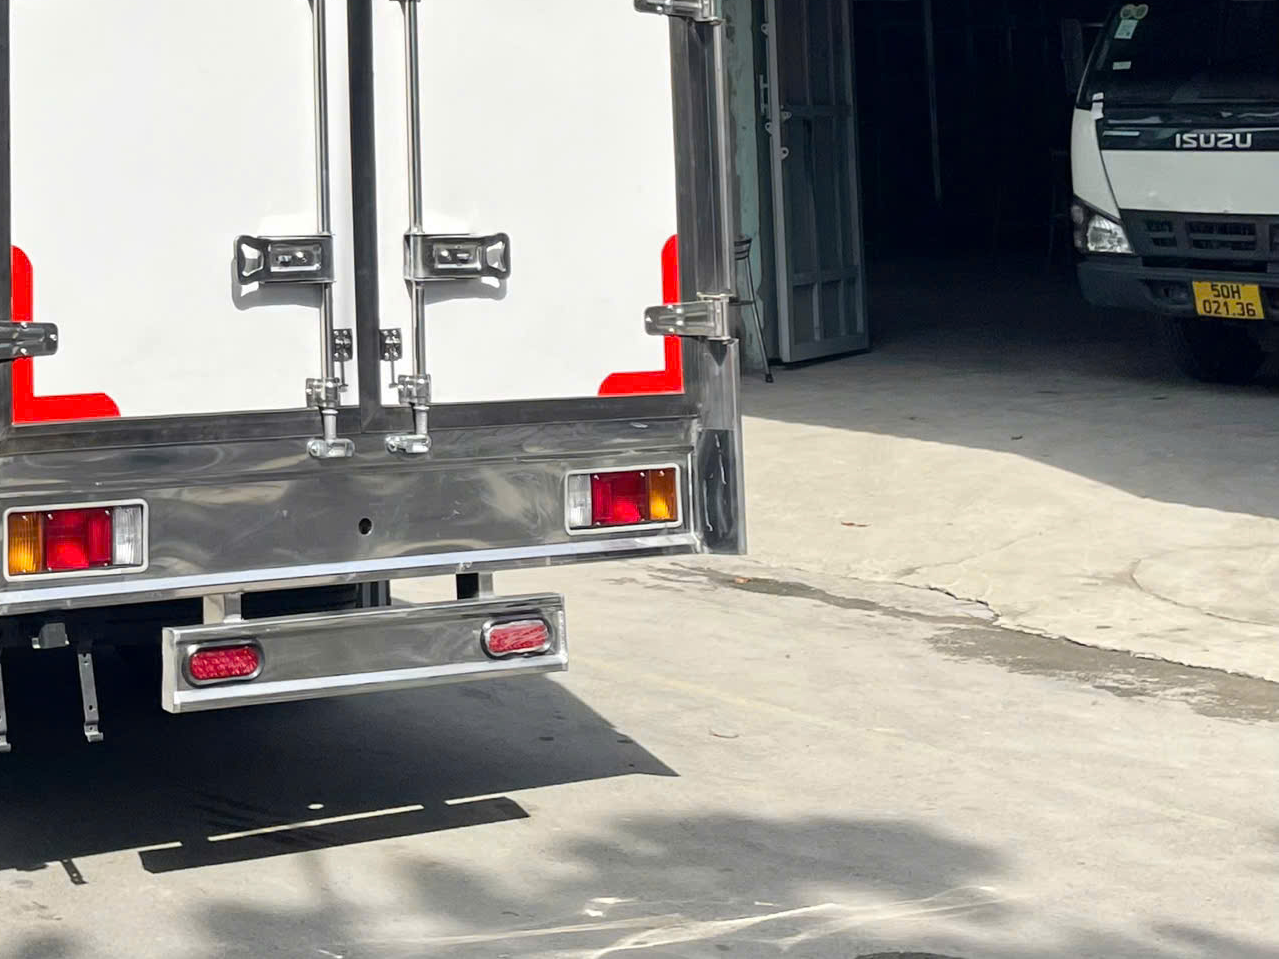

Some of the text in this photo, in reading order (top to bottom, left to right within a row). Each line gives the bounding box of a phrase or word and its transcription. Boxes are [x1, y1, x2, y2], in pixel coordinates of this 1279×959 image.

[1175, 133, 1252, 149] ISUZU
[1210, 283, 1242, 300] 50H
[1202, 299, 1257, 318] 021.36
